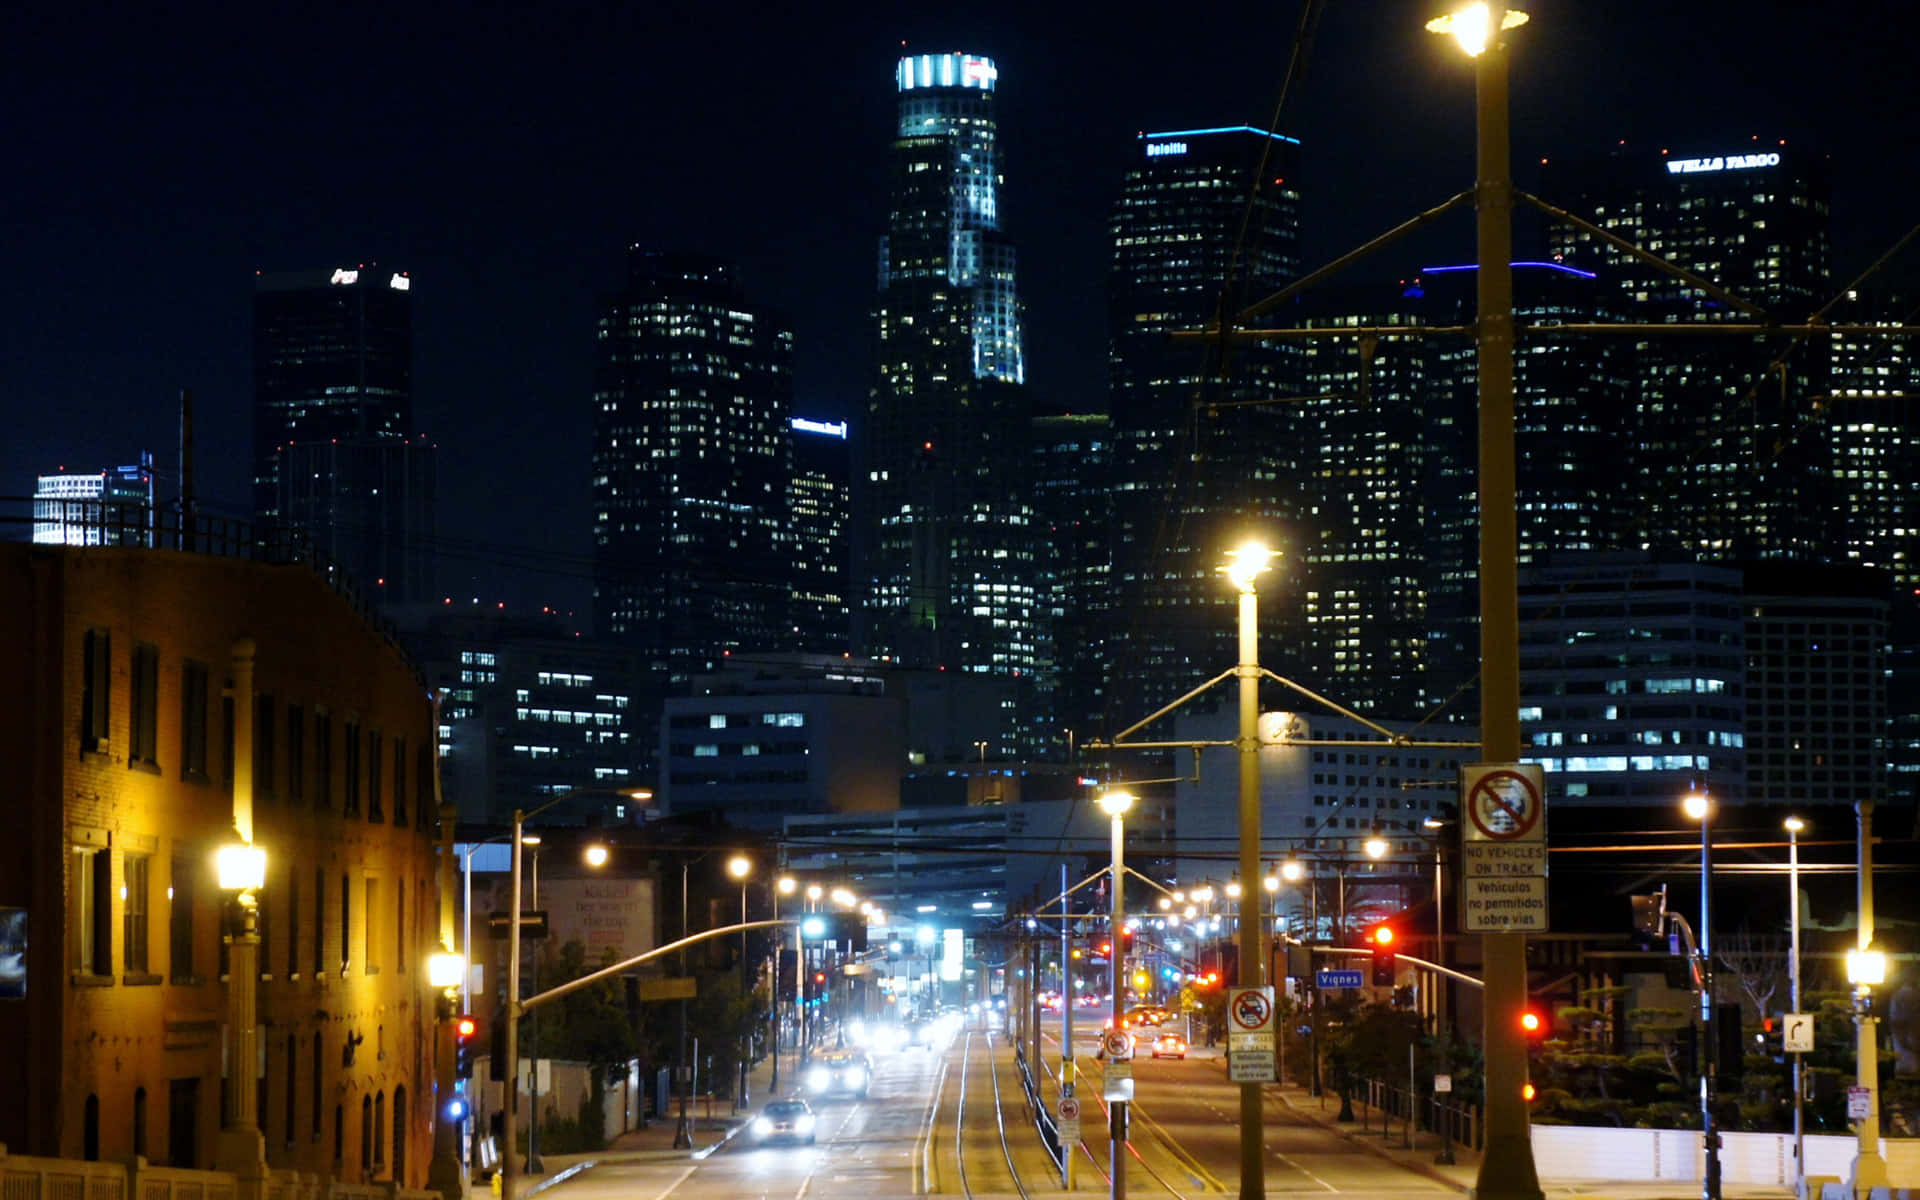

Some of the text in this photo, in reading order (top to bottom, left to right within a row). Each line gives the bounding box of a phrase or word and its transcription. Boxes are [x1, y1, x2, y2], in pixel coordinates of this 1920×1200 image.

[1147, 142, 1187, 156] Deloitte
[1666, 153, 1780, 173] WELLS FARGO
[1467, 847, 1544, 858] NO VEHICLES
[1475, 863, 1536, 874] ON TRACK
[1469, 897, 1544, 910] no permitidos
[1478, 914, 1510, 925] sobre
[1321, 975, 1358, 986] Vignes
